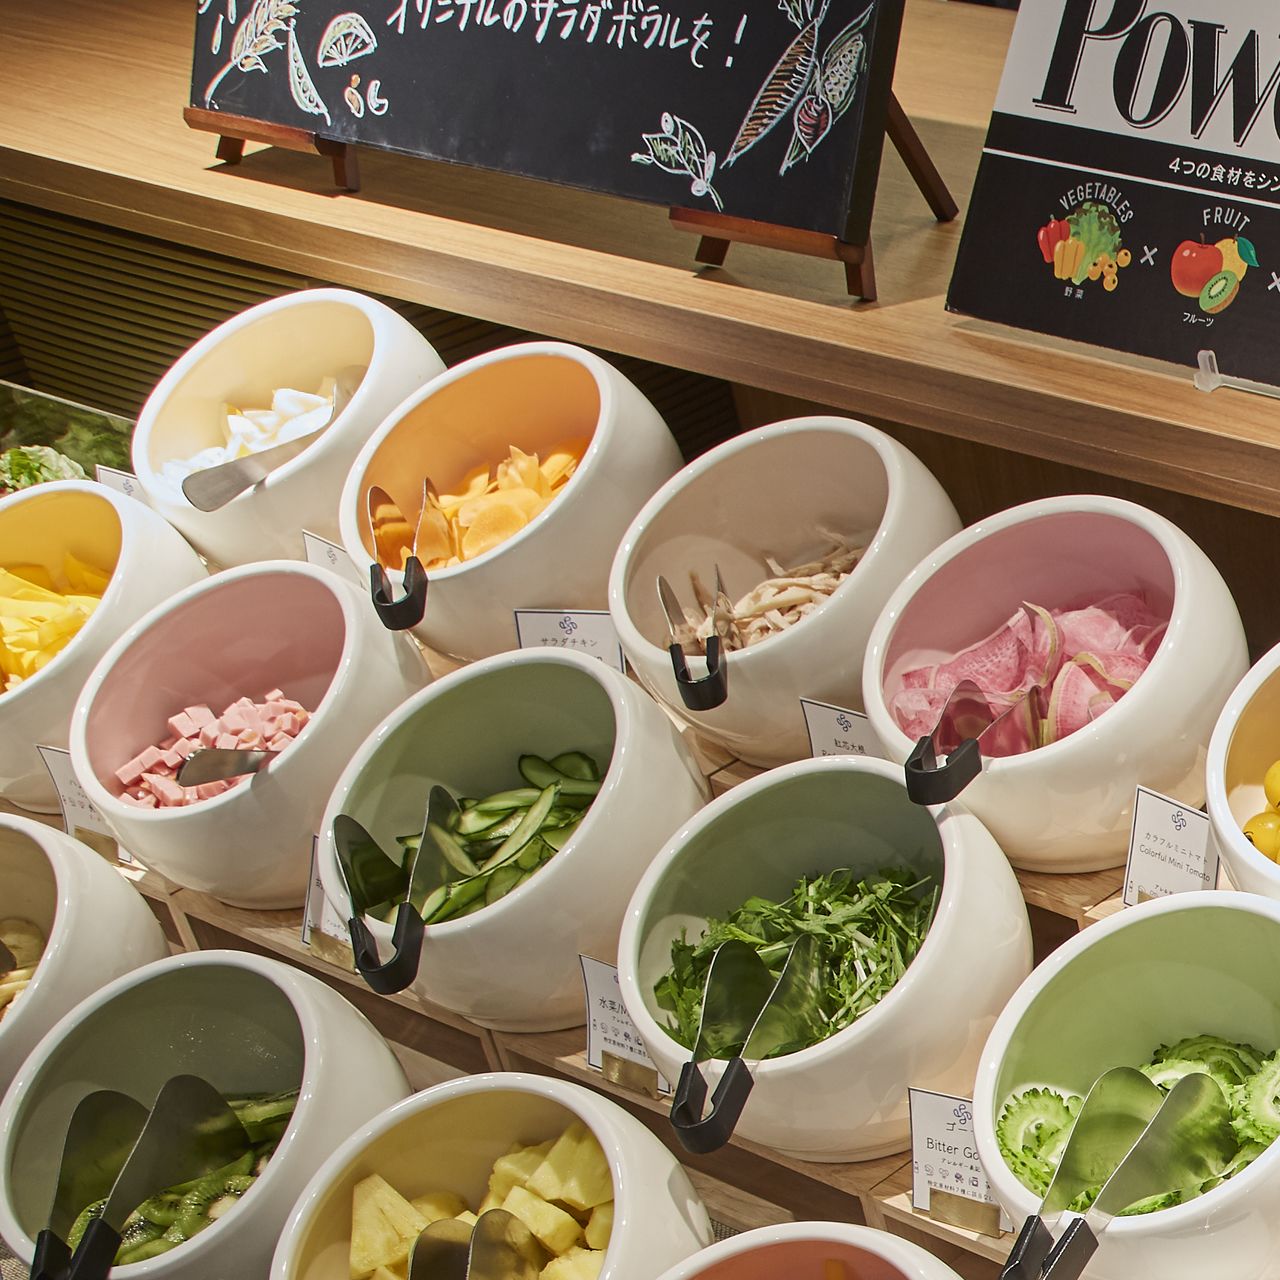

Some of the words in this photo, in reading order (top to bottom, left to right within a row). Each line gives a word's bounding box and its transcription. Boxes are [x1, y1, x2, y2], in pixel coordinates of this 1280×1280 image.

[1059, 181, 1133, 224] VEGETABLES
[1203, 206, 1251, 232] FRUIT
[1182, 312, 1215, 327] フルーツ
[541, 637, 598, 648] サラダチキン
[1144, 832, 1208, 865] カラフルミニトマト
[1139, 844, 1168, 863] Colorful
[1168, 857, 1183, 870] Mini
[1185, 864, 1211, 883] Tomato
[926, 1137, 959, 1155] Bitter
